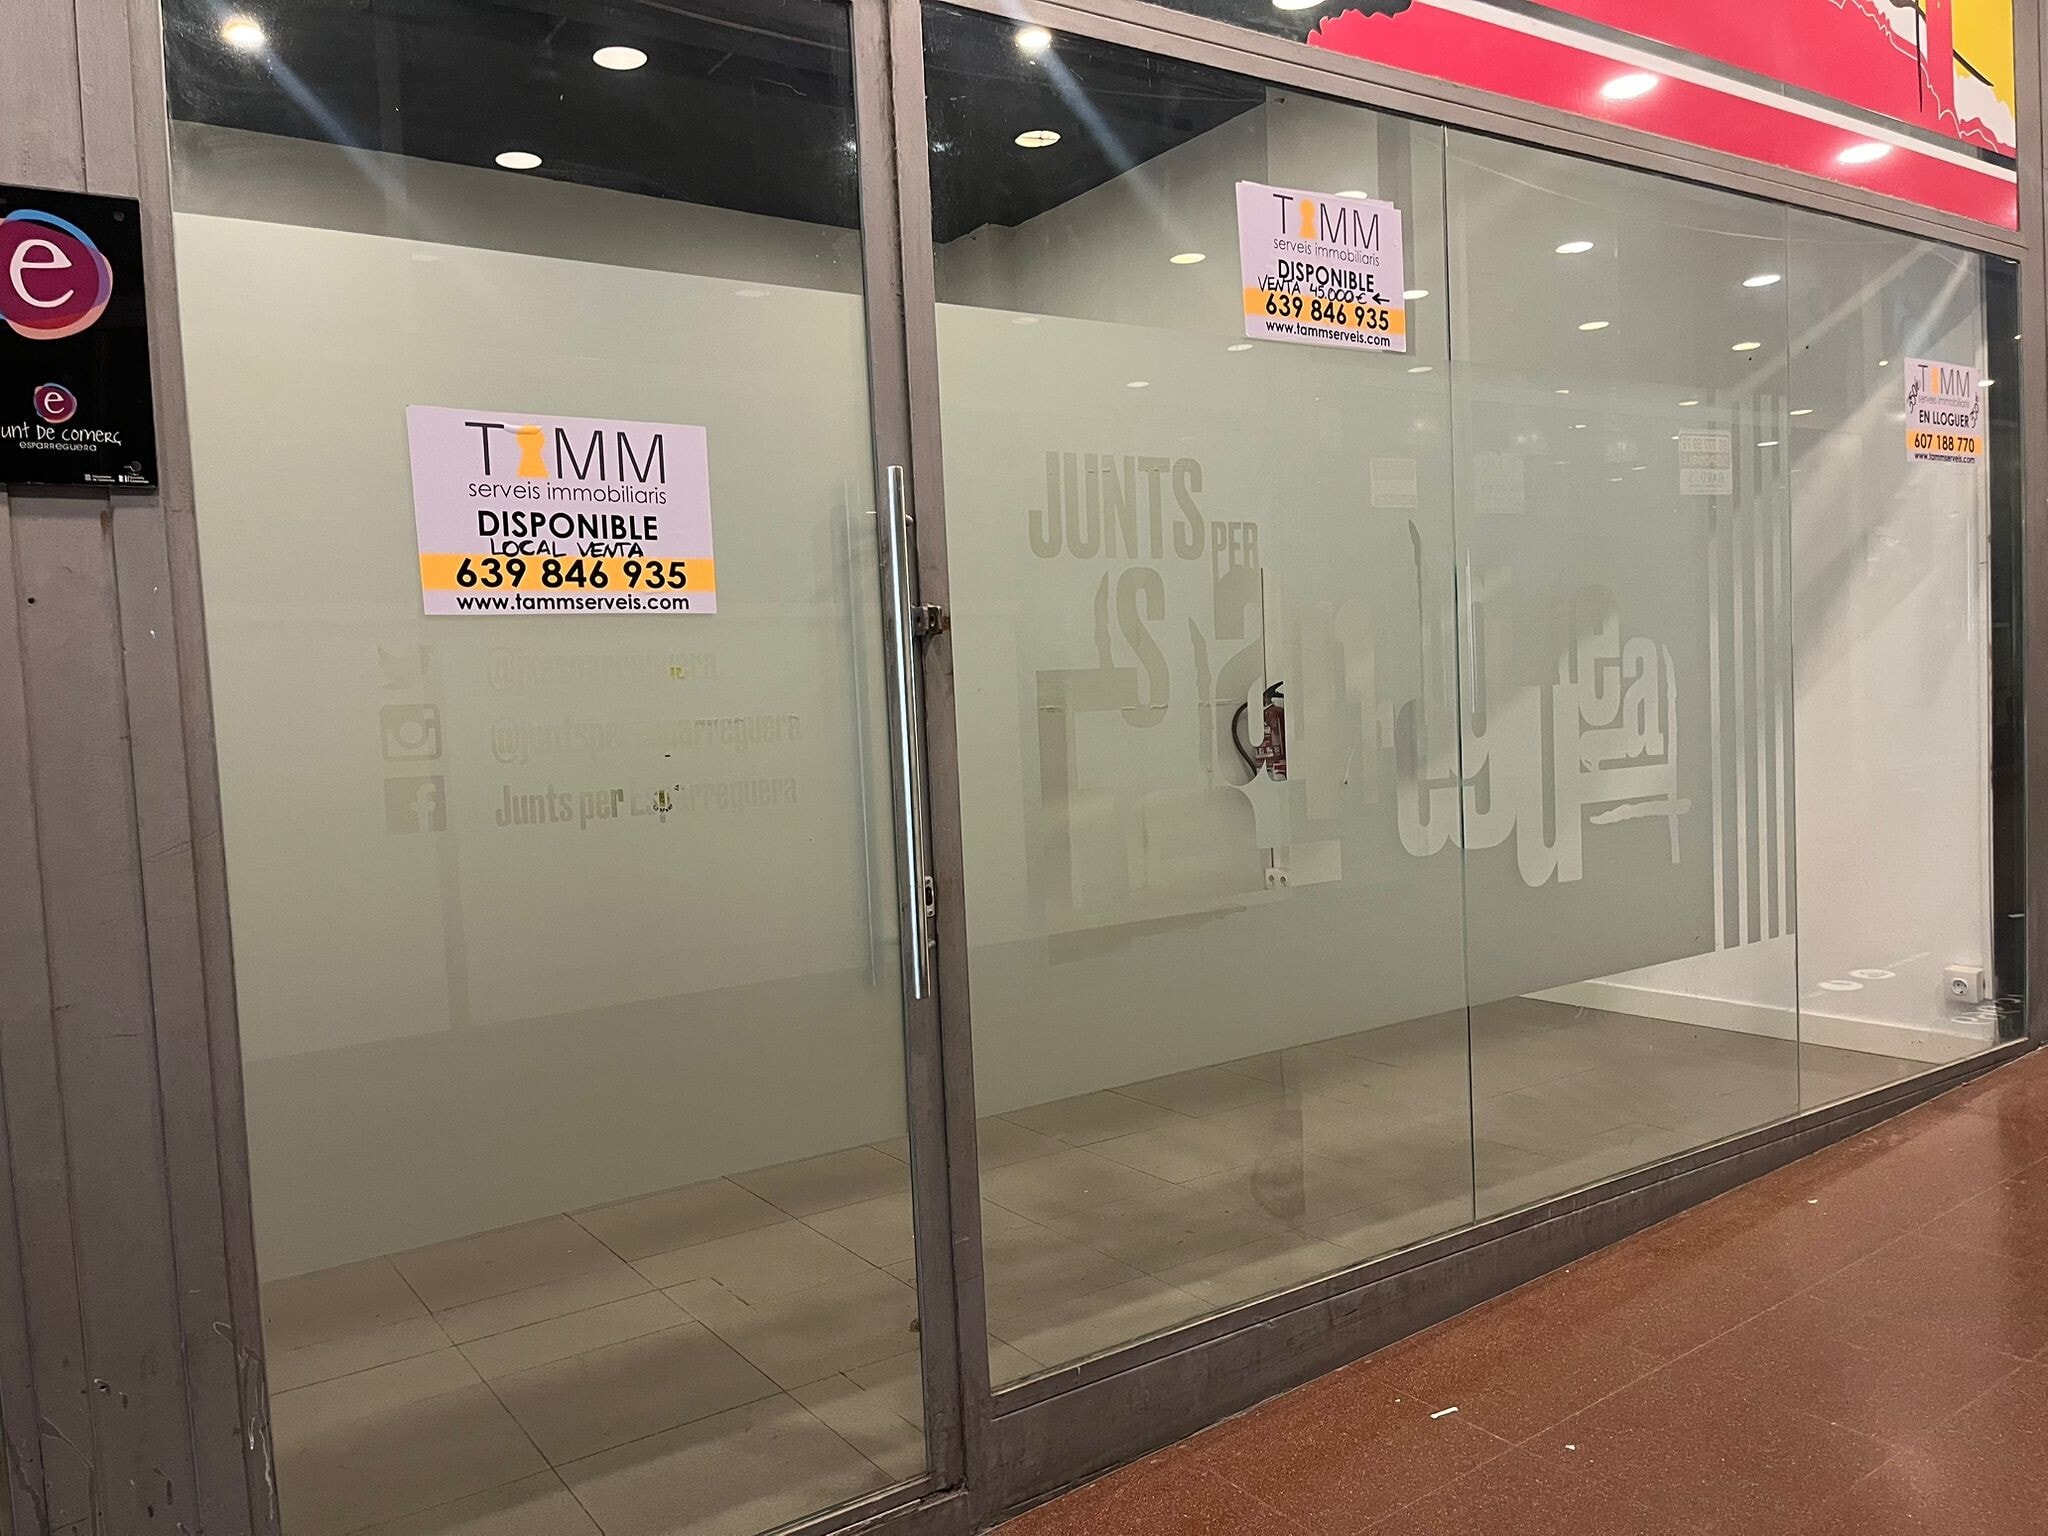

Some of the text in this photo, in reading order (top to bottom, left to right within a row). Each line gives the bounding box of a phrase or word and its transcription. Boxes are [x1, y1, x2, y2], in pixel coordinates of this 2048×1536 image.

[1273, 238, 1380, 267] serveis immobiliaris
[1258, 274, 1301, 295] VENTA
[1278, 259, 1374, 292] DISPONIBLE
[1266, 293, 1389, 331] 639 846 935
[1266, 320, 1390, 347] www.tammserveis.com
[1919, 410, 1969, 428] EN LLOGUER
[1914, 433, 1975, 453] 607 188 770
[468, 481, 667, 505] serveis immobiliaris
[1028, 451, 1205, 560] JUNTS
[477, 510, 658, 541] DISPONIBLE
[490, 538, 644, 559] LOCAL VENTA
[1211, 521, 1260, 570] PER
[456, 557, 687, 590] 639 846 935
[456, 593, 689, 611] www.tammserveis.com
[495, 784, 573, 827] Junts
[579, 788, 624, 830] per
